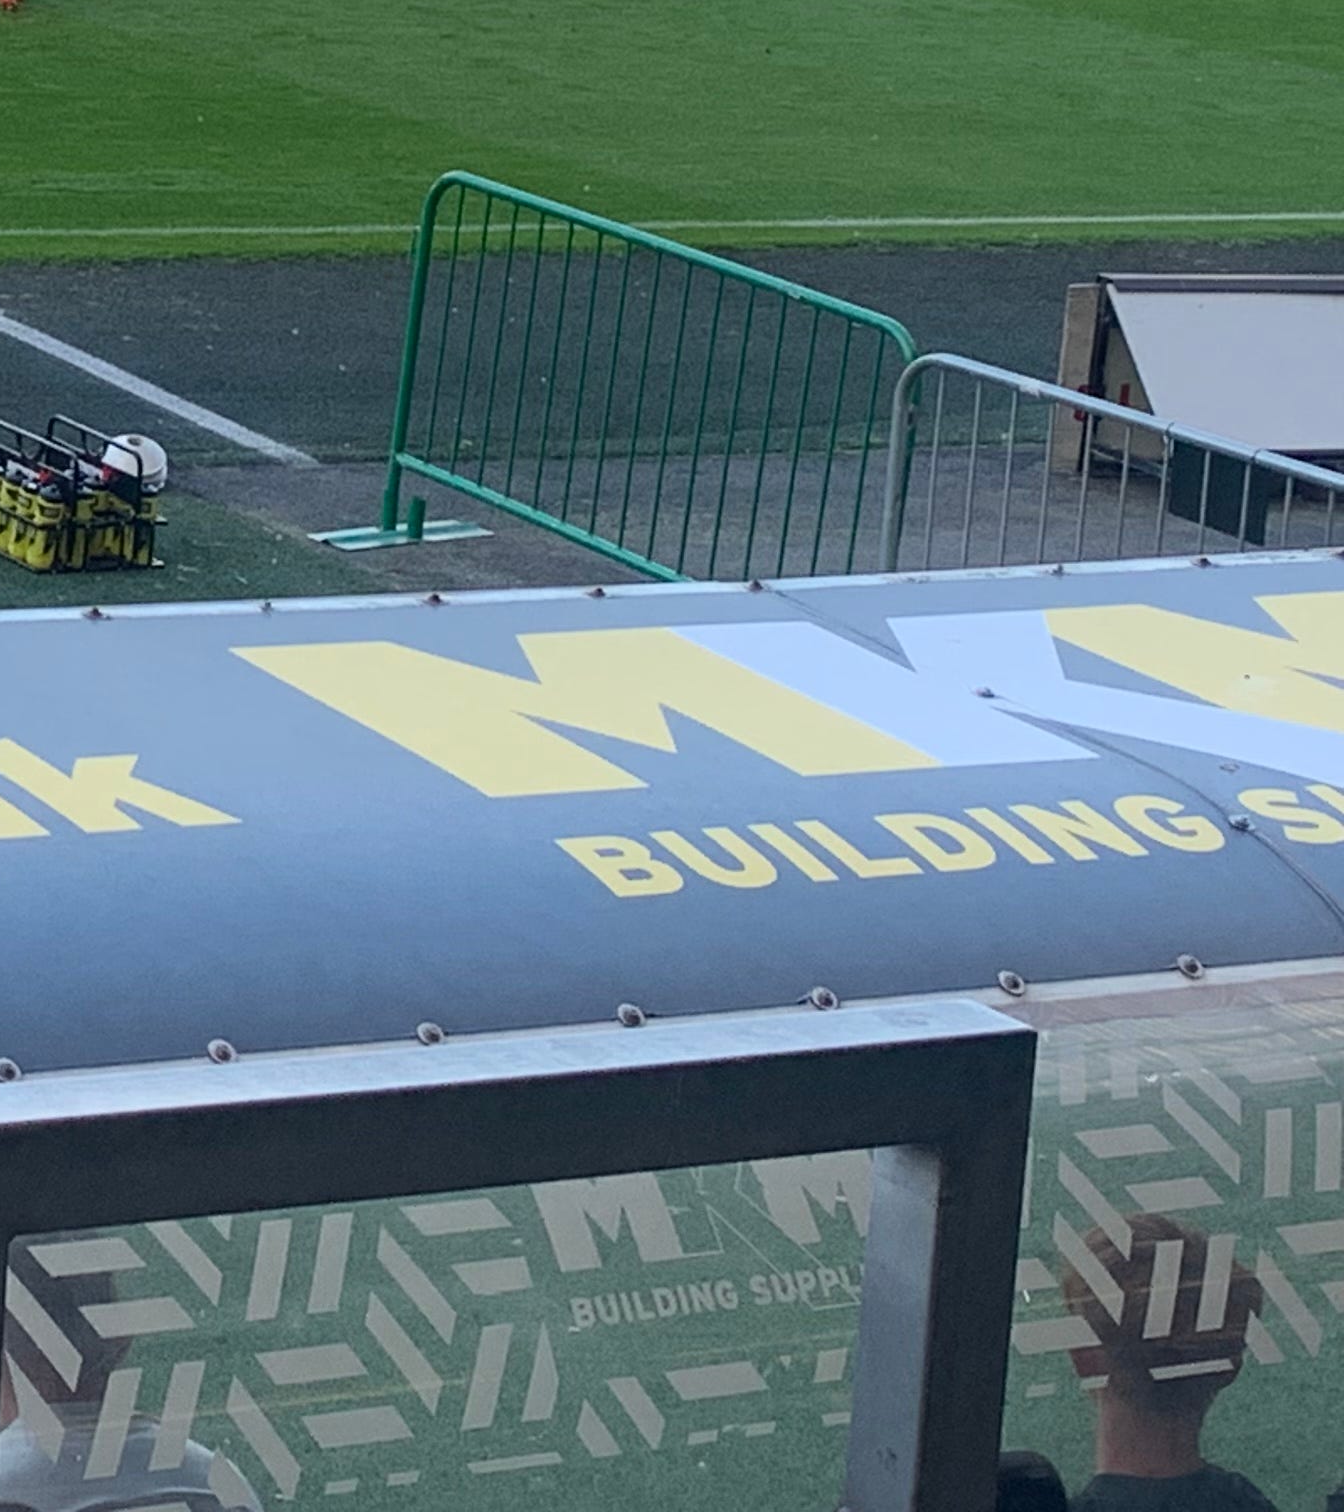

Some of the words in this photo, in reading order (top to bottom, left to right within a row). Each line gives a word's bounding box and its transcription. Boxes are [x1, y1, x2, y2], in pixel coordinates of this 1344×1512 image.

[554, 794, 1226, 899] BUILDING
[1237, 784, 1344, 844] S
[571, 1279, 739, 1328] BUILDING
